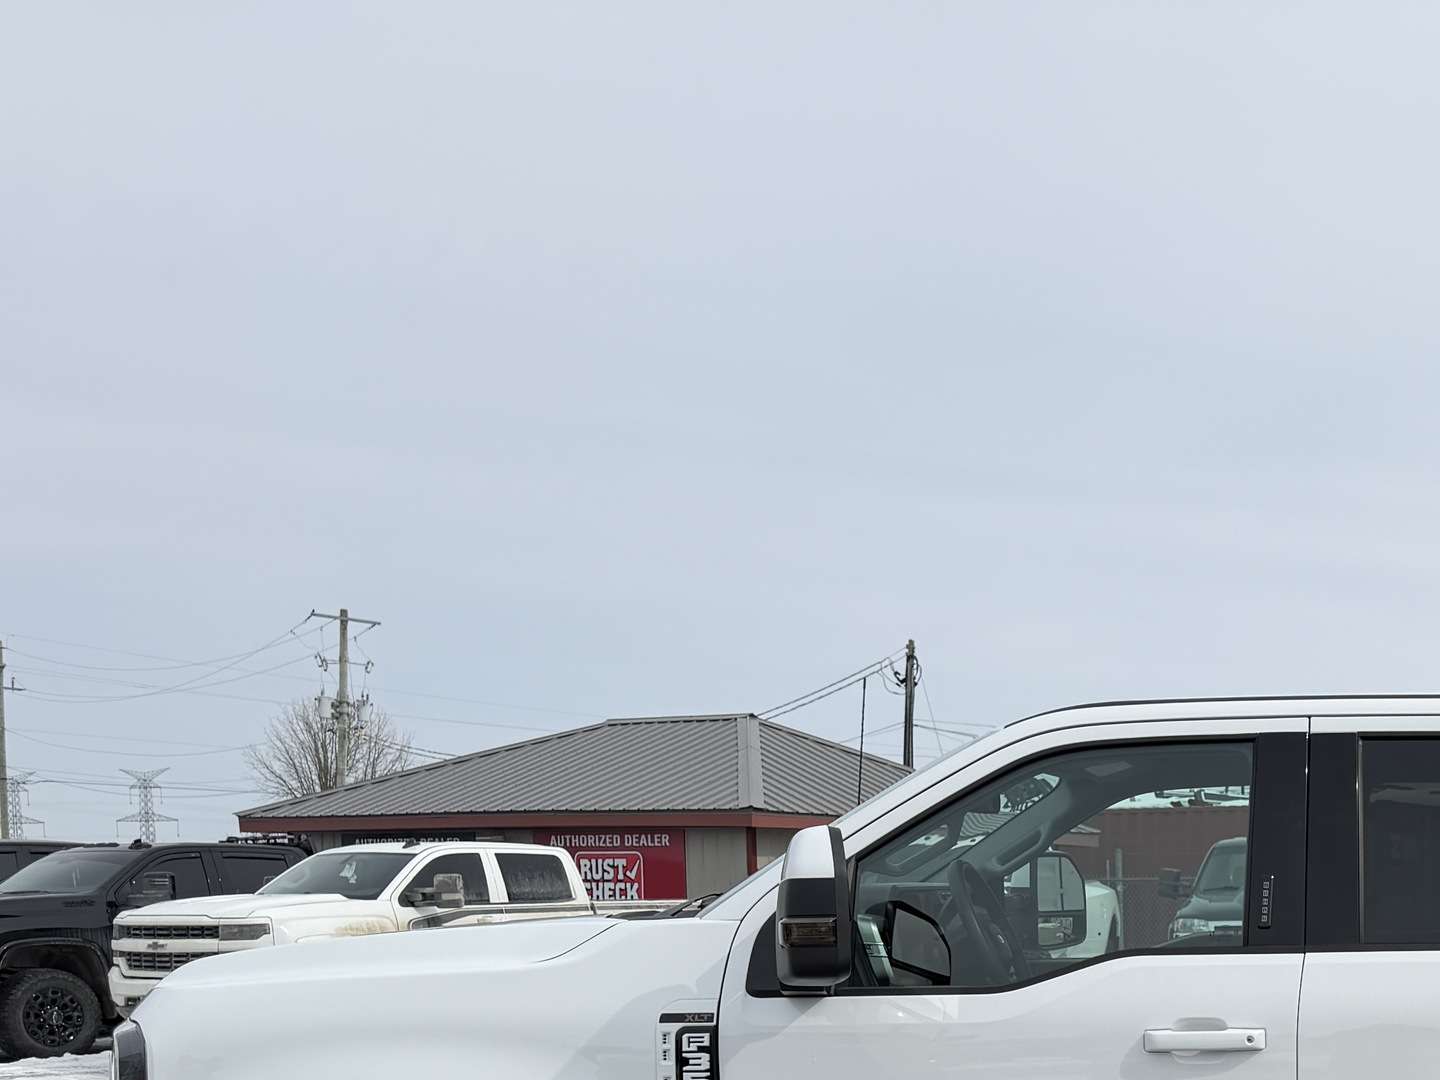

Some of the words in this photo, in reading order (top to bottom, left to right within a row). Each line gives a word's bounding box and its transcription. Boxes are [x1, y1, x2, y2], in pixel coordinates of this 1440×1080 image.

[550, 834, 621, 847] AUTHORIZED
[624, 833, 670, 847] DEALER
[580, 858, 627, 880] RUST
[684, 1013, 713, 1022] XLT
